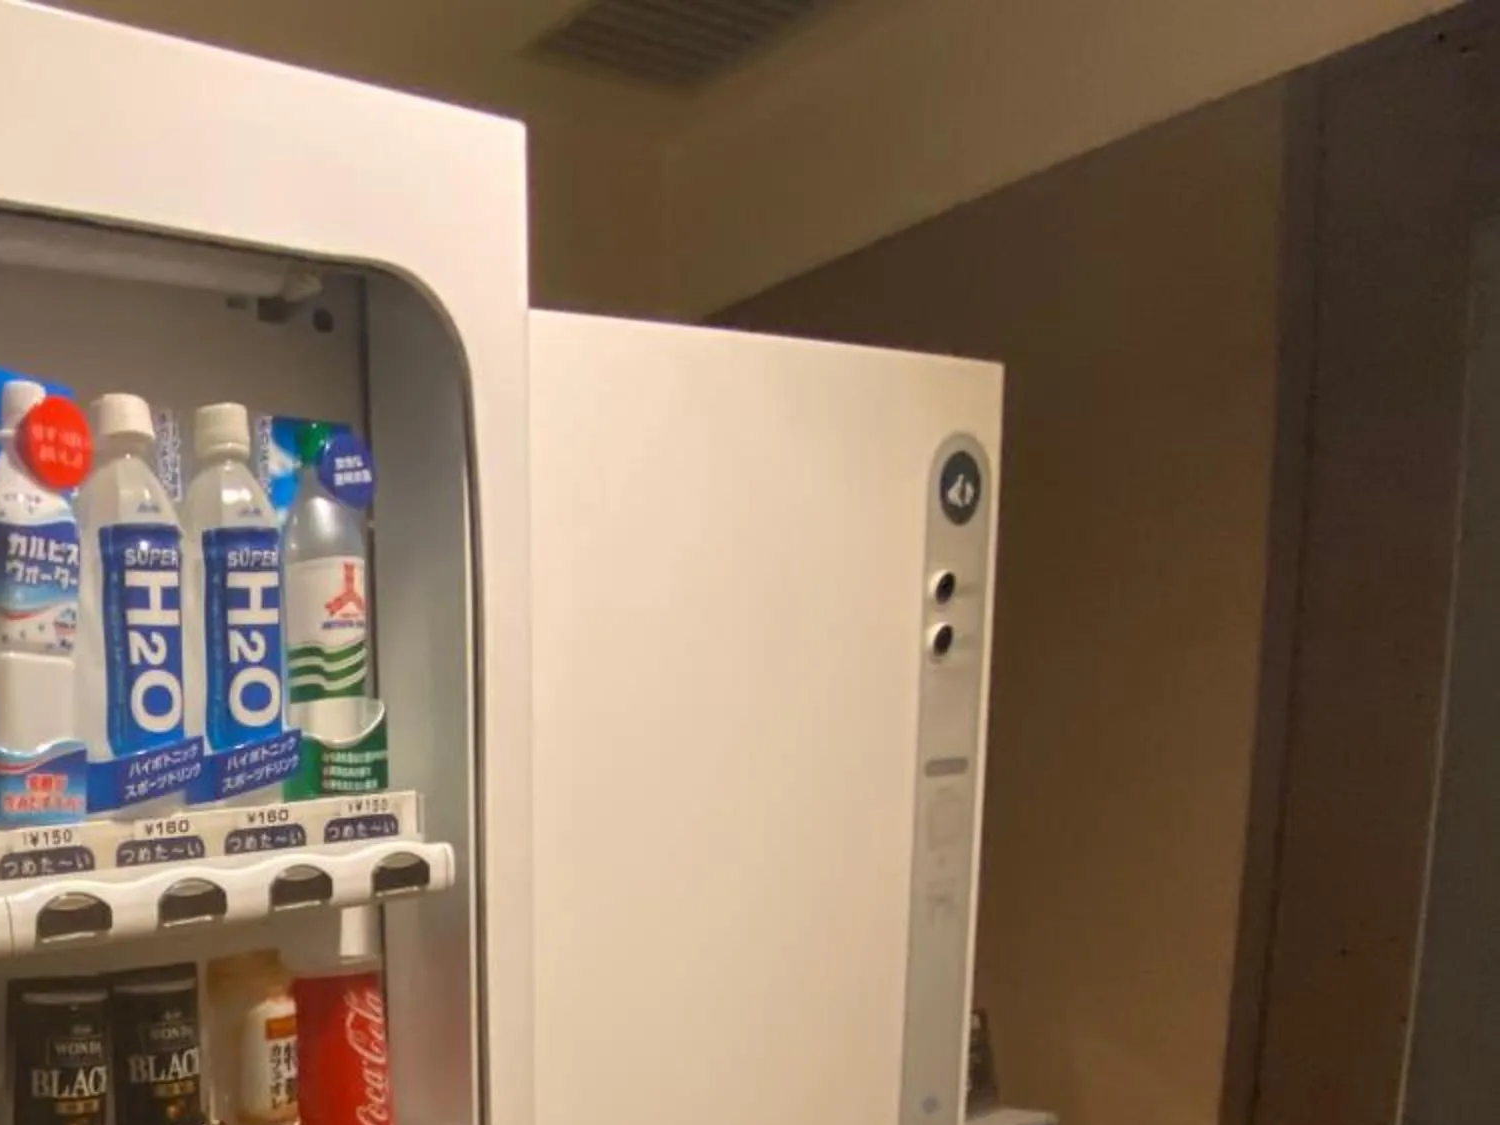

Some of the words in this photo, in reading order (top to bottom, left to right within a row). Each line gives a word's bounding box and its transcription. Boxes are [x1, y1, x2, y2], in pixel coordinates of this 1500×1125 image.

[8, 532, 80, 566] カルピス
[124, 547, 179, 568] SUPER
[227, 548, 279, 568] SUPER
[124, 570, 183, 733] H2O
[227, 570, 281, 728] H2O
[124, 762, 202, 800] スポーツドリンク
[221, 753, 300, 793] スポーツドリンク
